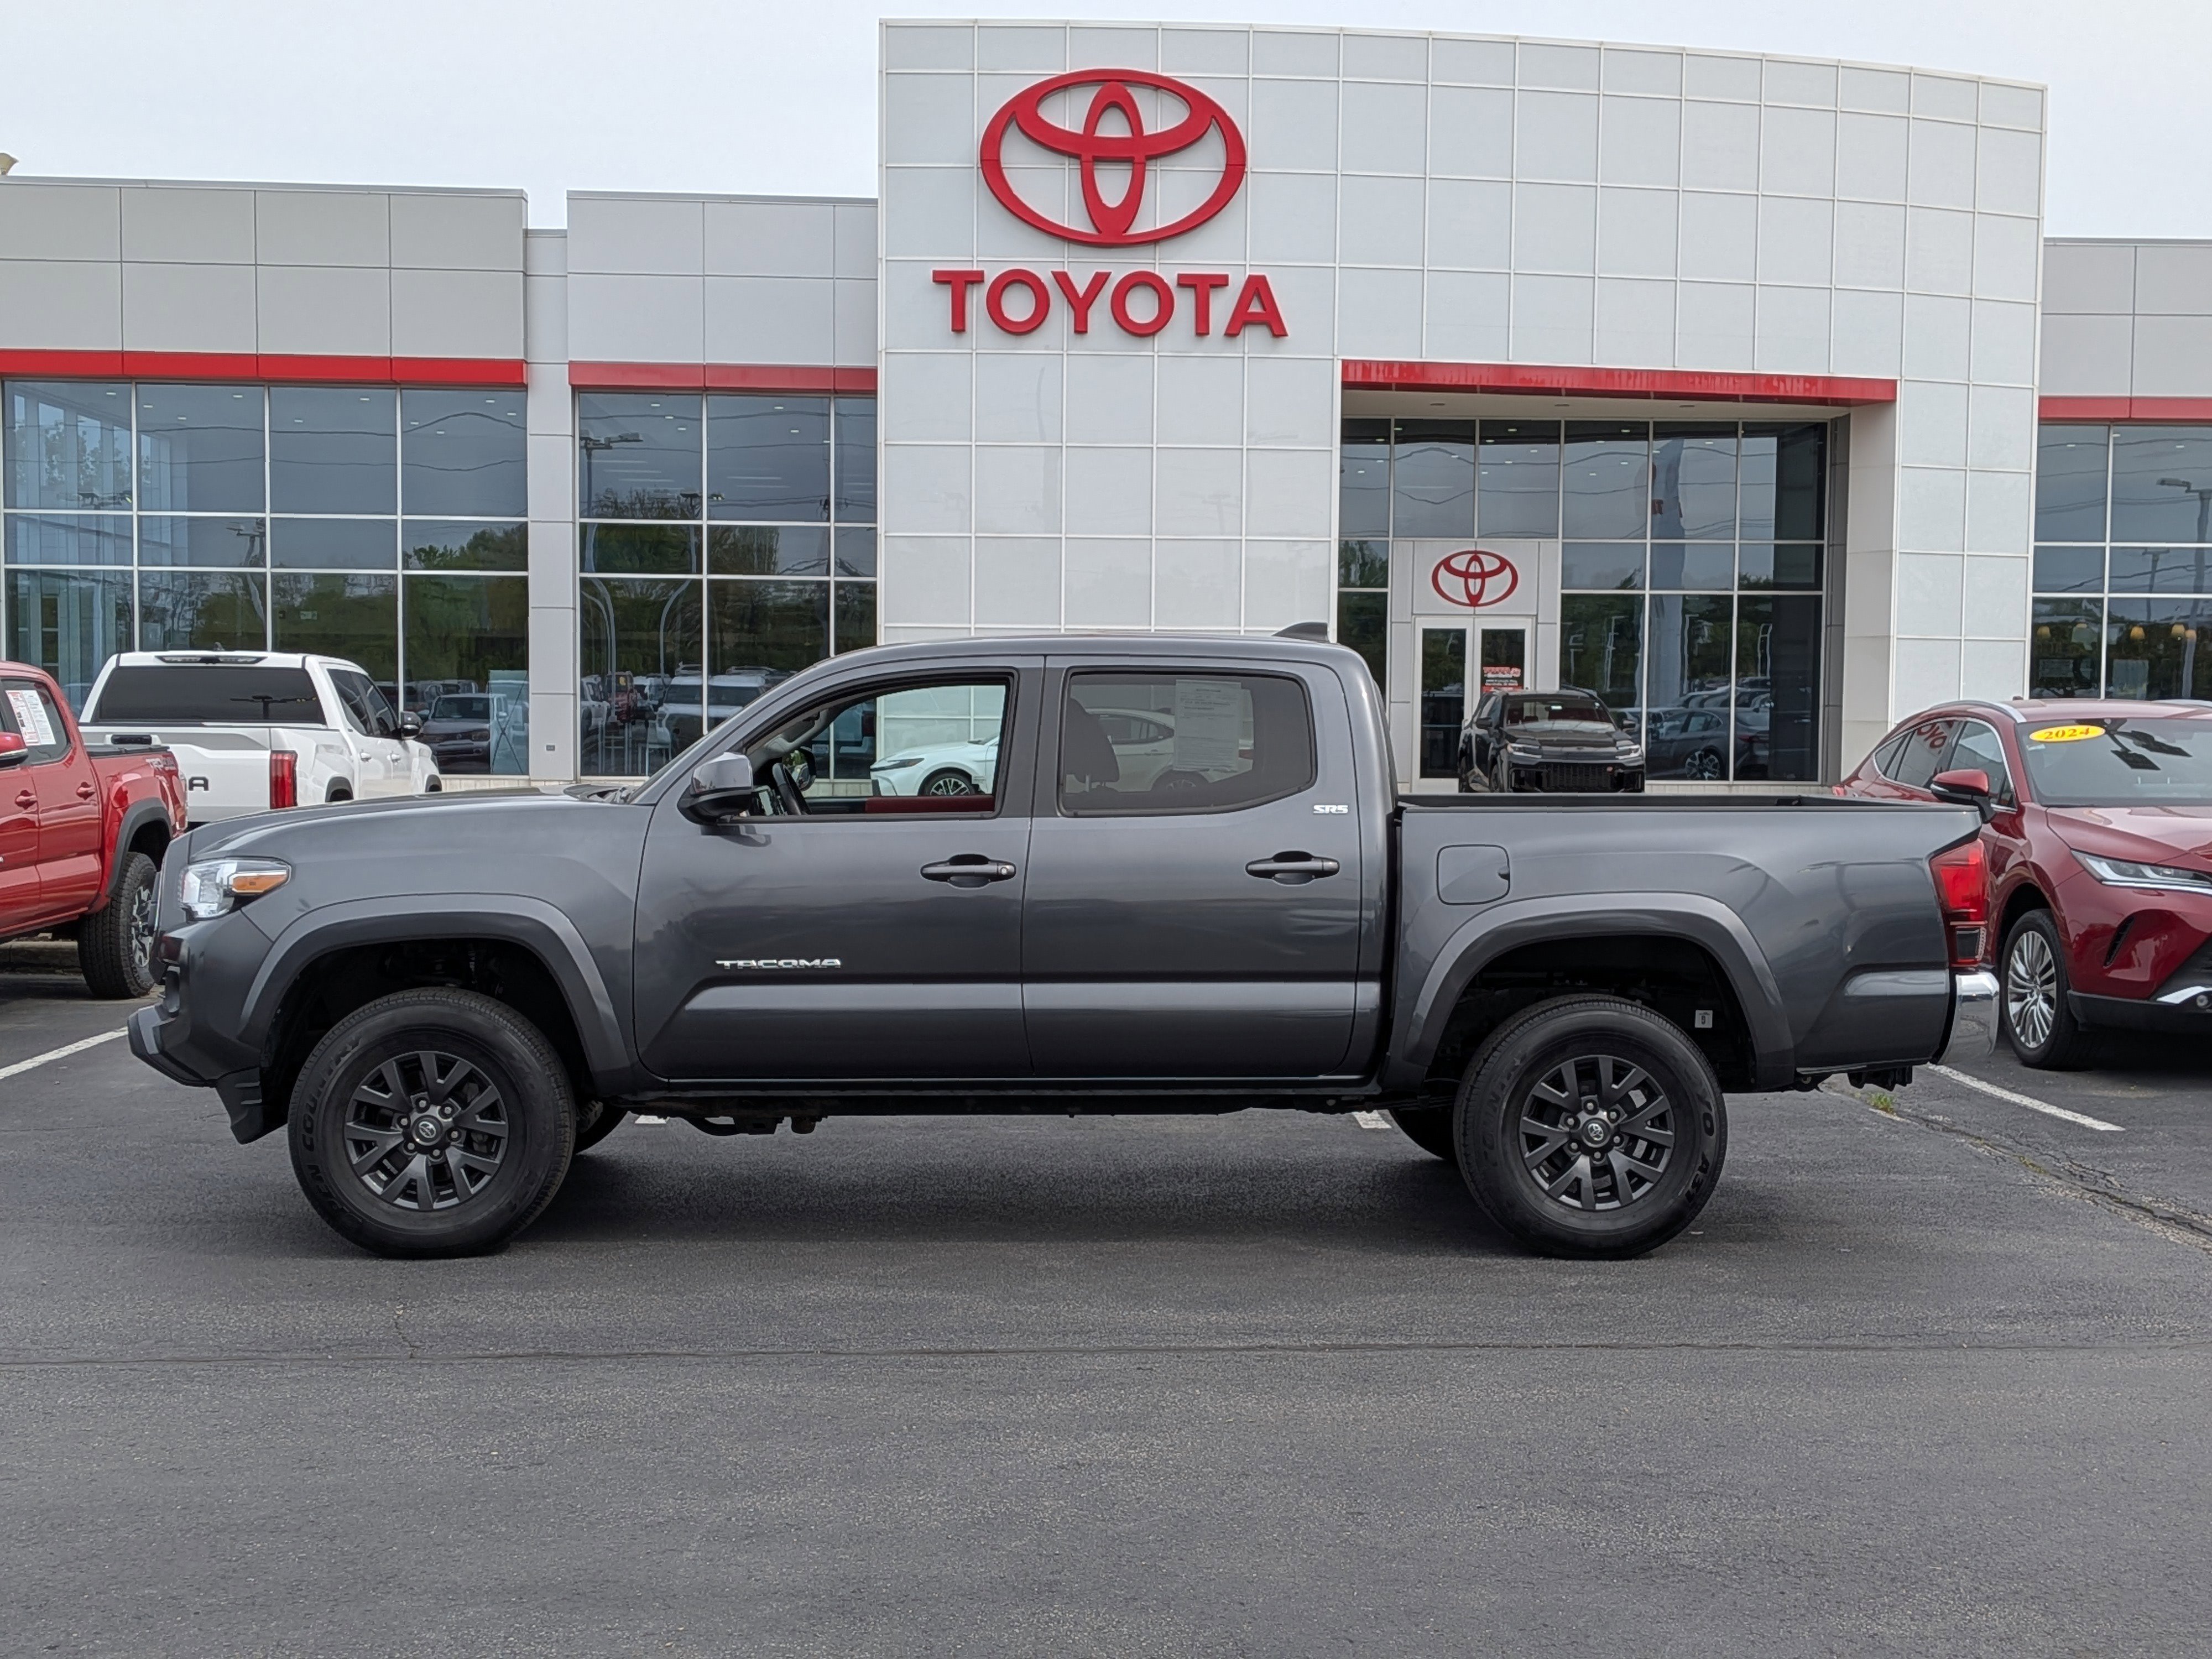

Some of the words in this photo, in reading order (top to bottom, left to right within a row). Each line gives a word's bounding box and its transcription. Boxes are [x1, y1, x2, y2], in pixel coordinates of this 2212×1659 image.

[932, 269, 1288, 337] TOYOTA
[2044, 727, 2090, 739] 2024
[1313, 805, 1348, 813] SR5
[715, 959, 841, 969] TACOMA
